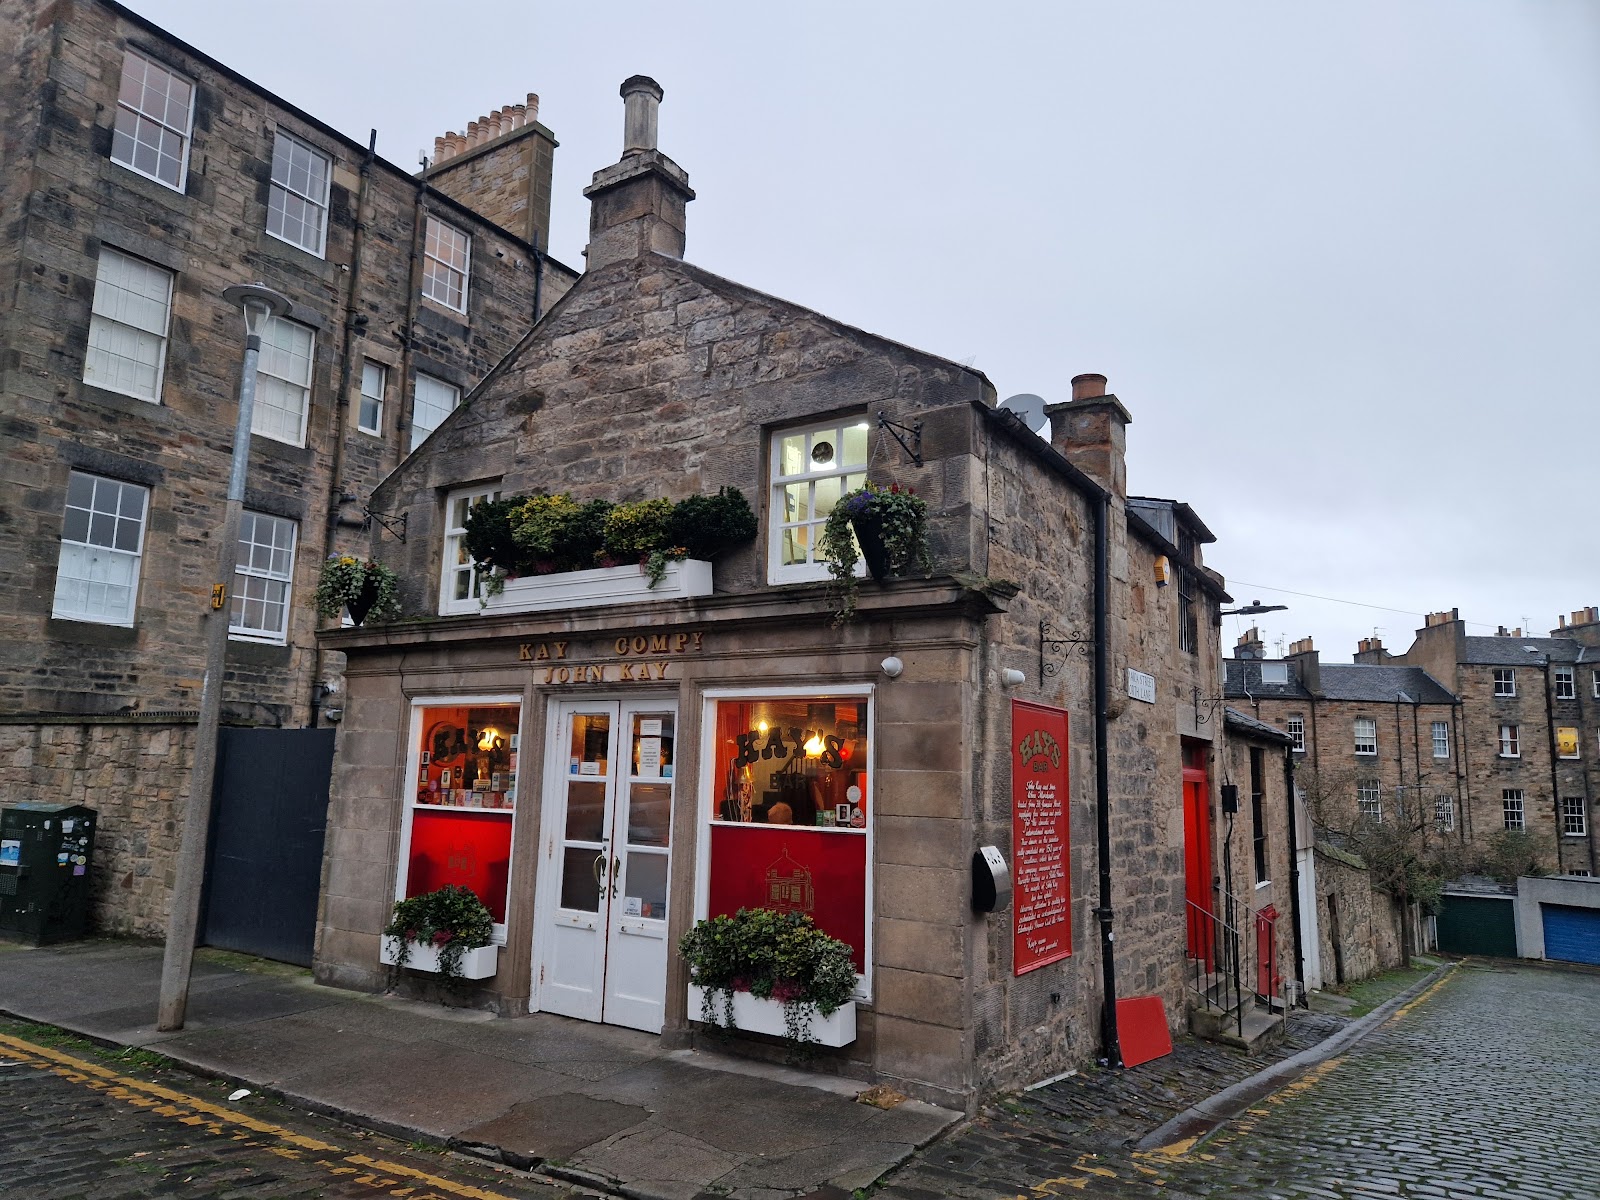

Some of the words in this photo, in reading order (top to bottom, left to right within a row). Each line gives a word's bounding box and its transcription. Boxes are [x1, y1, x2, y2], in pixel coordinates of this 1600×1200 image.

[519, 641, 568, 662] KAY
[543, 664, 605, 685] JOHN
[619, 659, 669, 682] KAY
[1140, 675, 1154, 689] STREET
[1141, 688, 1152, 701] LANE
[735, 726, 846, 769] KAY'S
[1018, 729, 1062, 769] KAY'S
[1033, 761, 1048, 772] BAR
